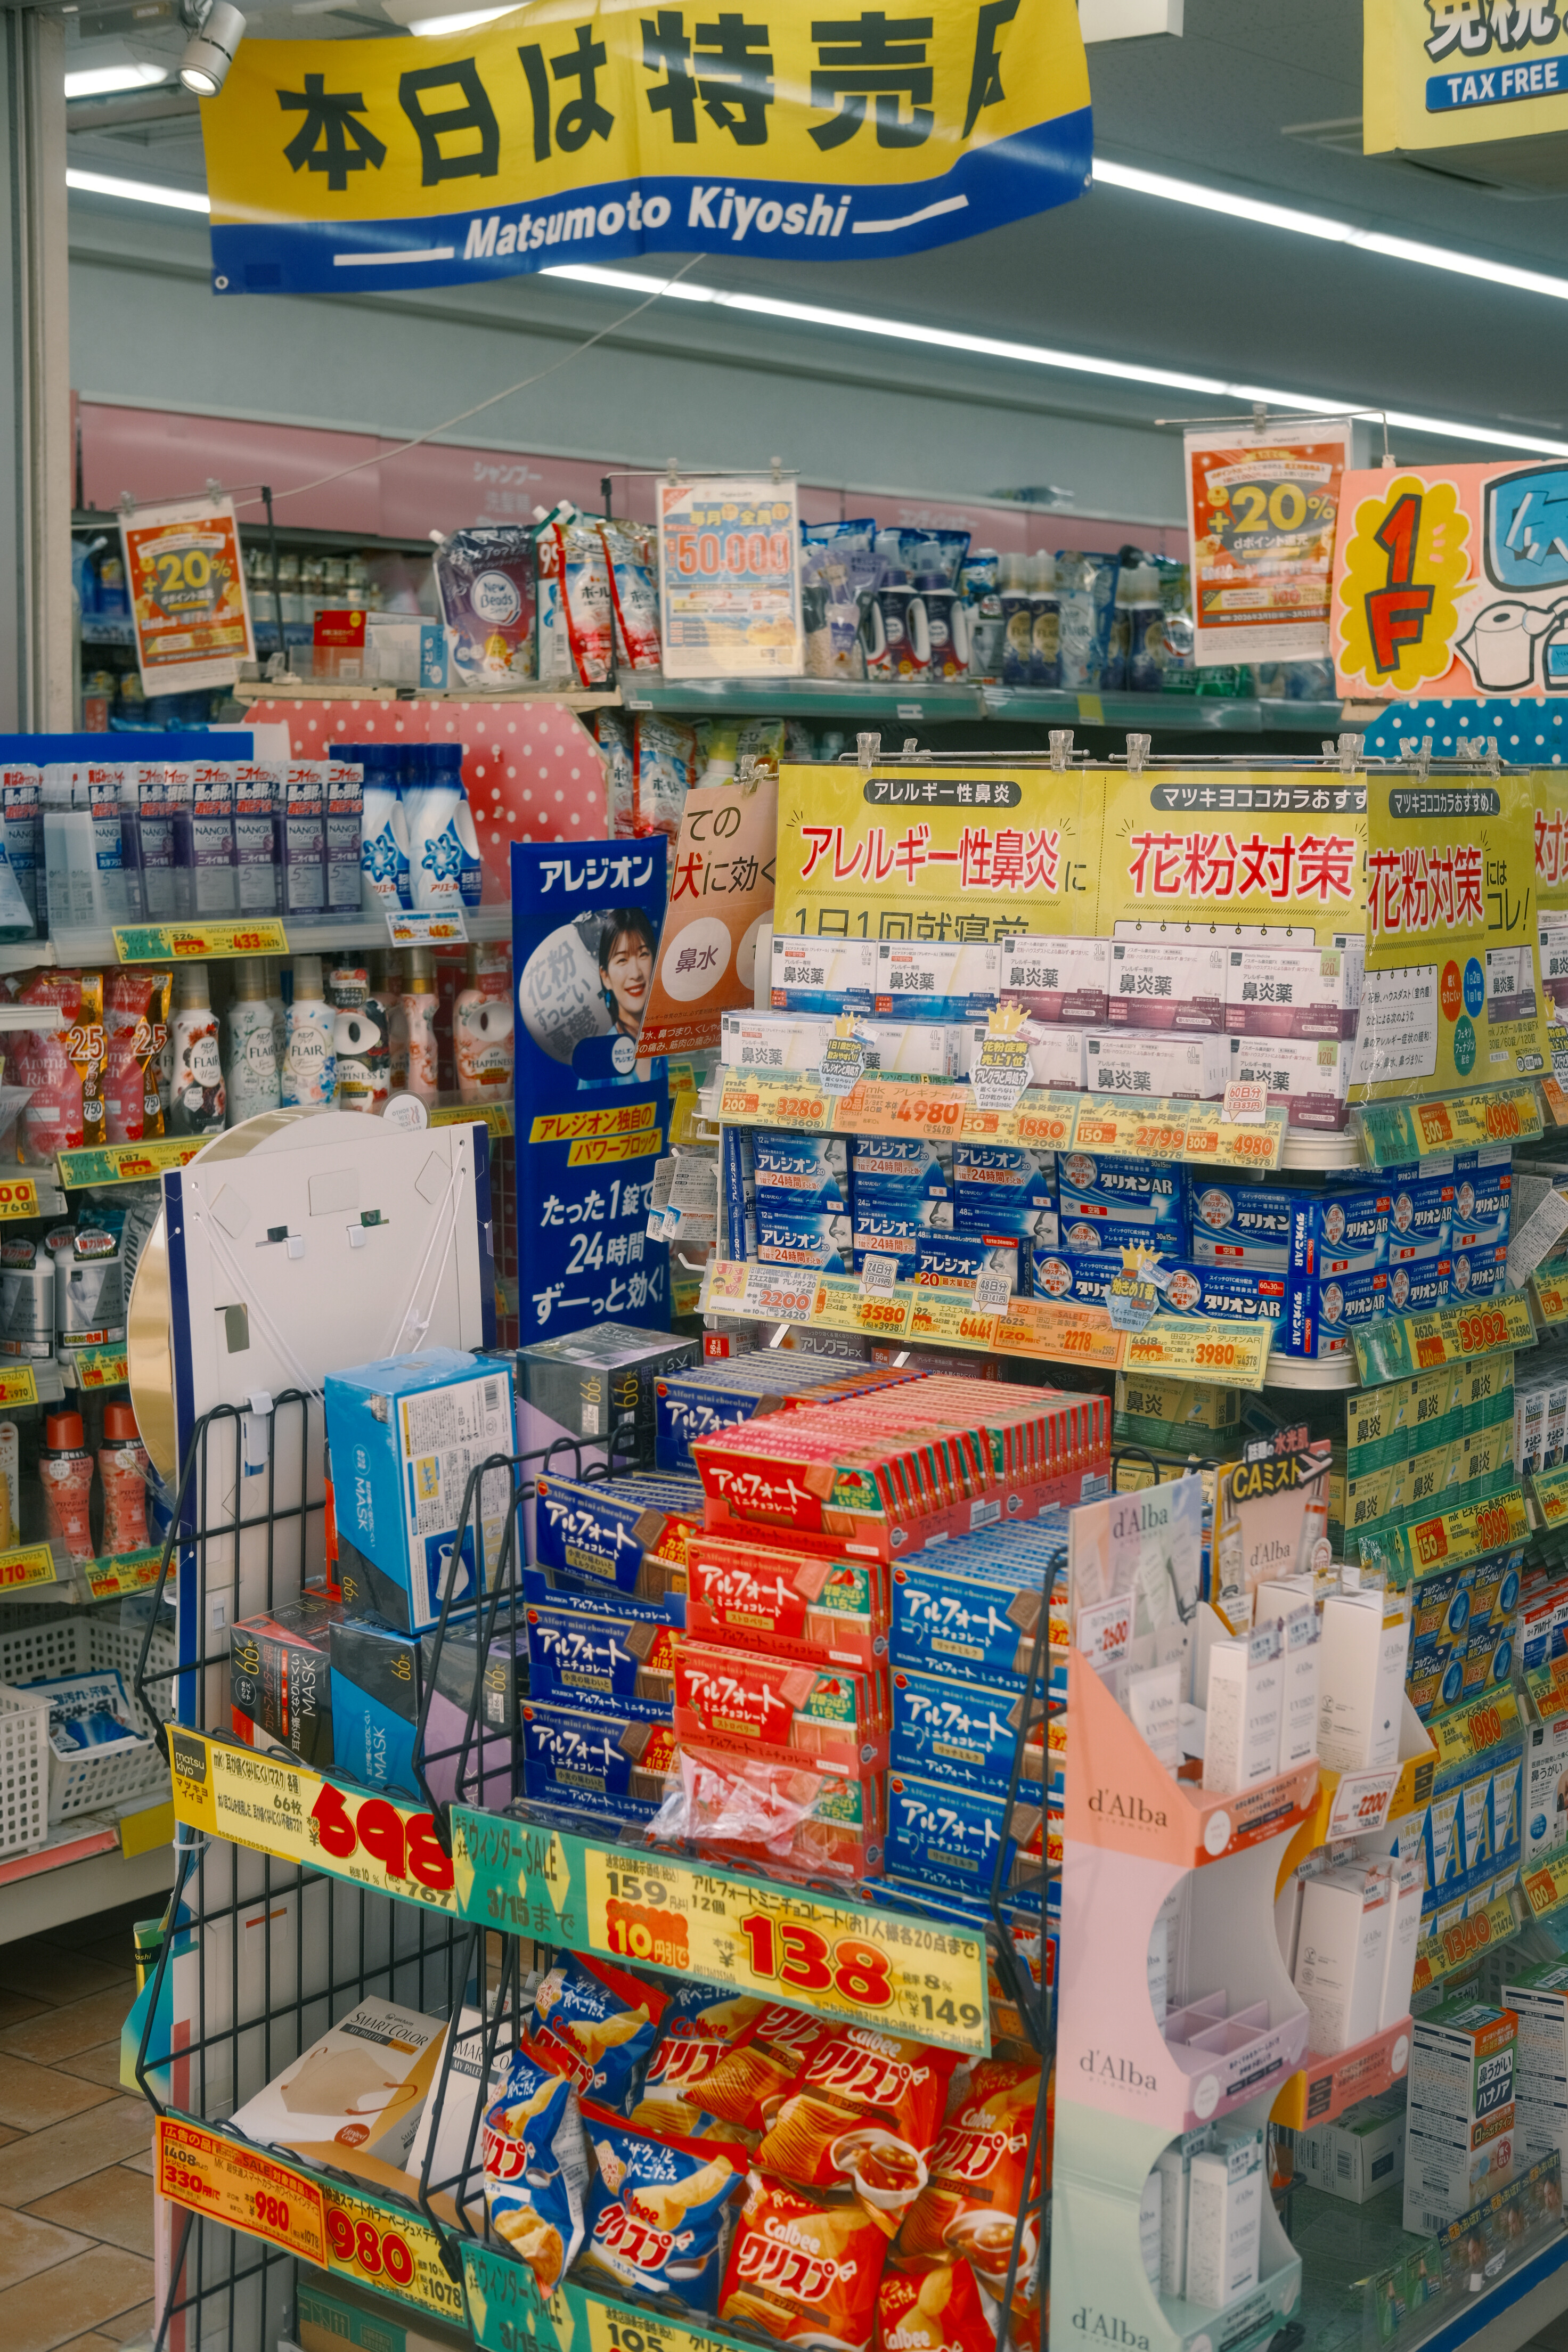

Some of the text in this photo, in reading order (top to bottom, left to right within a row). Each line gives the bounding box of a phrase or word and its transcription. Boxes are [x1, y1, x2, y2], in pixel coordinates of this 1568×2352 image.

[1447, 62, 1558, 103] TAX FREE
[463, 186, 852, 260] Matsumoto Kiyoshi
[1208, 483, 1336, 533] +20%
[483, 581, 506, 593] New
[480, 594, 513, 608] Beads
[874, 782, 1010, 803] アレルギー性鼻炎
[1162, 788, 1367, 810] マツキヨココカラおすす
[1394, 793, 1493, 813] マツキヨココカラおすすめ!
[687, 807, 741, 841] ての
[540, 856, 653, 893] アレジオン
[1128, 832, 1355, 900] 花粉対策
[1487, 860, 1507, 886] には
[430, 883, 460, 893] アリエール
[1368, 846, 1484, 932] 花粉対策
[1488, 887, 1530, 931] コレ!
[795, 909, 1030, 943] 1日1回就寝前
[233, 933, 260, 949] 433
[675, 945, 718, 974] 鼻水
[783, 967, 824, 985] 鼻炎薬
[889, 972, 935, 991] 鼻炎薬
[1010, 967, 1058, 987] 鼻炎薬
[1119, 973, 1172, 996] 鼻炎薬
[1447, 975, 1455, 987] 眠く
[1467, 971, 1481, 984] 1日2回
[1242, 982, 1292, 1003] 鼻炎薬
[1443, 991, 1460, 1003] なりにくい
[1467, 989, 1482, 1002] 1回1錠
[70, 1026, 104, 1060] 2.5
[133, 1024, 167, 1056] 2.5
[291, 1046, 324, 1056] FLAIR
[983, 1041, 1028, 1054] 花粉症薬
[20, 1057, 67, 1070] Aroma
[471, 1058, 513, 1068] HAPPINESS
[741, 1047, 782, 1065] 鼻炎薬
[981, 1055, 1025, 1067] 売上1位
[1461, 1055, 1469, 1064] 配合
[27, 1072, 57, 1086] Rich
[1098, 1068, 1151, 1091] 鼻炎薬
[145, 1096, 159, 1107] 750
[893, 1088, 963, 1100] アレギナール
[1228, 1087, 1261, 1099] 60日分
[85, 1103, 102, 1114] 750
[725, 1101, 745, 1112] 200
[775, 1097, 824, 1120] 3280
[896, 1099, 958, 1124] 4980
[1228, 1101, 1261, 1110] 1日83円
[540, 1106, 652, 1140] アレジオン独自の
[1017, 1118, 1066, 1140] 1880
[1486, 1099, 1521, 1139] 4980
[574, 1132, 658, 1162] パワーブロック
[1136, 1126, 1185, 1149] 2799
[1232, 1134, 1274, 1156] 4980
[118, 1154, 139, 1162] 487
[857, 1139, 920, 1160] アレジオン
[957, 1149, 1023, 1167] アレジオン
[758, 1155, 817, 1173] アレジオン
[1100, 1174, 1172, 1195] タリオンAR
[540, 1180, 651, 1227] たった1錠で
[1475, 1195, 1509, 1214] タリオンAR
[1346, 1217, 1388, 1238] タリオンAR
[1414, 1207, 1452, 1226] タリオンAR
[761, 1229, 821, 1249] アレジオン
[566, 1231, 645, 1275] 24時間
[867, 1262, 893, 1275] 24日分
[921, 1255, 984, 1275] アレジオン
[748, 1275, 816, 1288] エスエス製薬 アレジオン20
[864, 1275, 891, 1286] 1日149円
[920, 1272, 976, 1288] 20 最大量配合
[979, 1279, 1009, 1292] 48日分
[1111, 1279, 1155, 1300] 効きめ1番
[758, 1289, 811, 1310] 2200
[978, 1293, 1006, 1304] 1日141円
[1204, 1295, 1280, 1318] タリオンAR
[861, 1303, 905, 1323] 3580
[1065, 1330, 1092, 1351] 2278
[1217, 1335, 1260, 1344] タリオンAR
[1458, 1310, 1509, 1354] 3982
[800, 1337, 863, 1357] アレグラFX
[1195, 1343, 1235, 1364] 3980
[1525, 1402, 1544, 1415] Nasivin
[1357, 1415, 1381, 1443] 鼻炎
[708, 1468, 812, 1504] アルフォート
[1232, 1457, 1300, 1496] CAミスト
[545, 1500, 637, 1549] アルフォート
[1113, 1504, 1169, 1540] d'Alba
[1476, 1505, 1509, 1551] 2999
[561, 1533, 619, 1561] ミニチョコレート
[1250, 1544, 1291, 1567] d'Alba
[697, 1564, 799, 1602] アルフォート
[824, 1585, 865, 1600] 甘酸っぱい
[717, 1596, 782, 1619] ミニチョコレート
[825, 1594, 860, 1612] いちご
[903, 1588, 1013, 1637] アルフォート
[729, 1613, 770, 1628] ストロベリー
[536, 1628, 631, 1664] アルフォート
[924, 1622, 992, 1648] ミニチョコレート
[303, 1657, 316, 1717] MASK
[684, 1670, 786, 1713] アルフォート
[904, 1693, 1014, 1742] アルフォート
[1468, 1703, 1501, 1754] 1980
[373, 1726, 388, 1780] MASK
[532, 1725, 625, 1762] アルフォート
[176, 1751, 205, 1770] matsu
[177, 1762, 194, 1777] kiyo
[1531, 1761, 1563, 1782] 鼻うがい
[176, 1777, 208, 1797] マツキヨ
[182, 1789, 203, 1804] イイヨ
[273, 1794, 303, 1816] 66枚
[1088, 1789, 1169, 1828] d'Alba
[900, 1799, 1001, 1848] アルフォート
[311, 1781, 455, 1891] 698
[405, 1880, 450, 1907] 767
[692, 1894, 725, 1915] 12個
[487, 1888, 575, 1940] 3/15まで
[1443, 1910, 1491, 1964] 1340
[740, 1910, 895, 2009] 138
[921, 1994, 981, 2029] 149
[671, 2016, 728, 2038] Calbee
[847, 2027, 903, 2057] Calbee
[805, 2040, 911, 2106] クリスプ
[1080, 2049, 1158, 2092] d'Alba
[1478, 2056, 1513, 2086] 鼻うがい
[1477, 2079, 1511, 2113] ハナノア
[165, 2125, 211, 2152] 広告の品
[255, 2191, 289, 2232] 980
[326, 2207, 415, 2287] 980
[594, 2202, 675, 2271] クリスプ
[764, 2217, 821, 2255] Calbee
[737, 2232, 839, 2302] クリスプ
[1072, 2307, 1150, 2351] d'Alba
